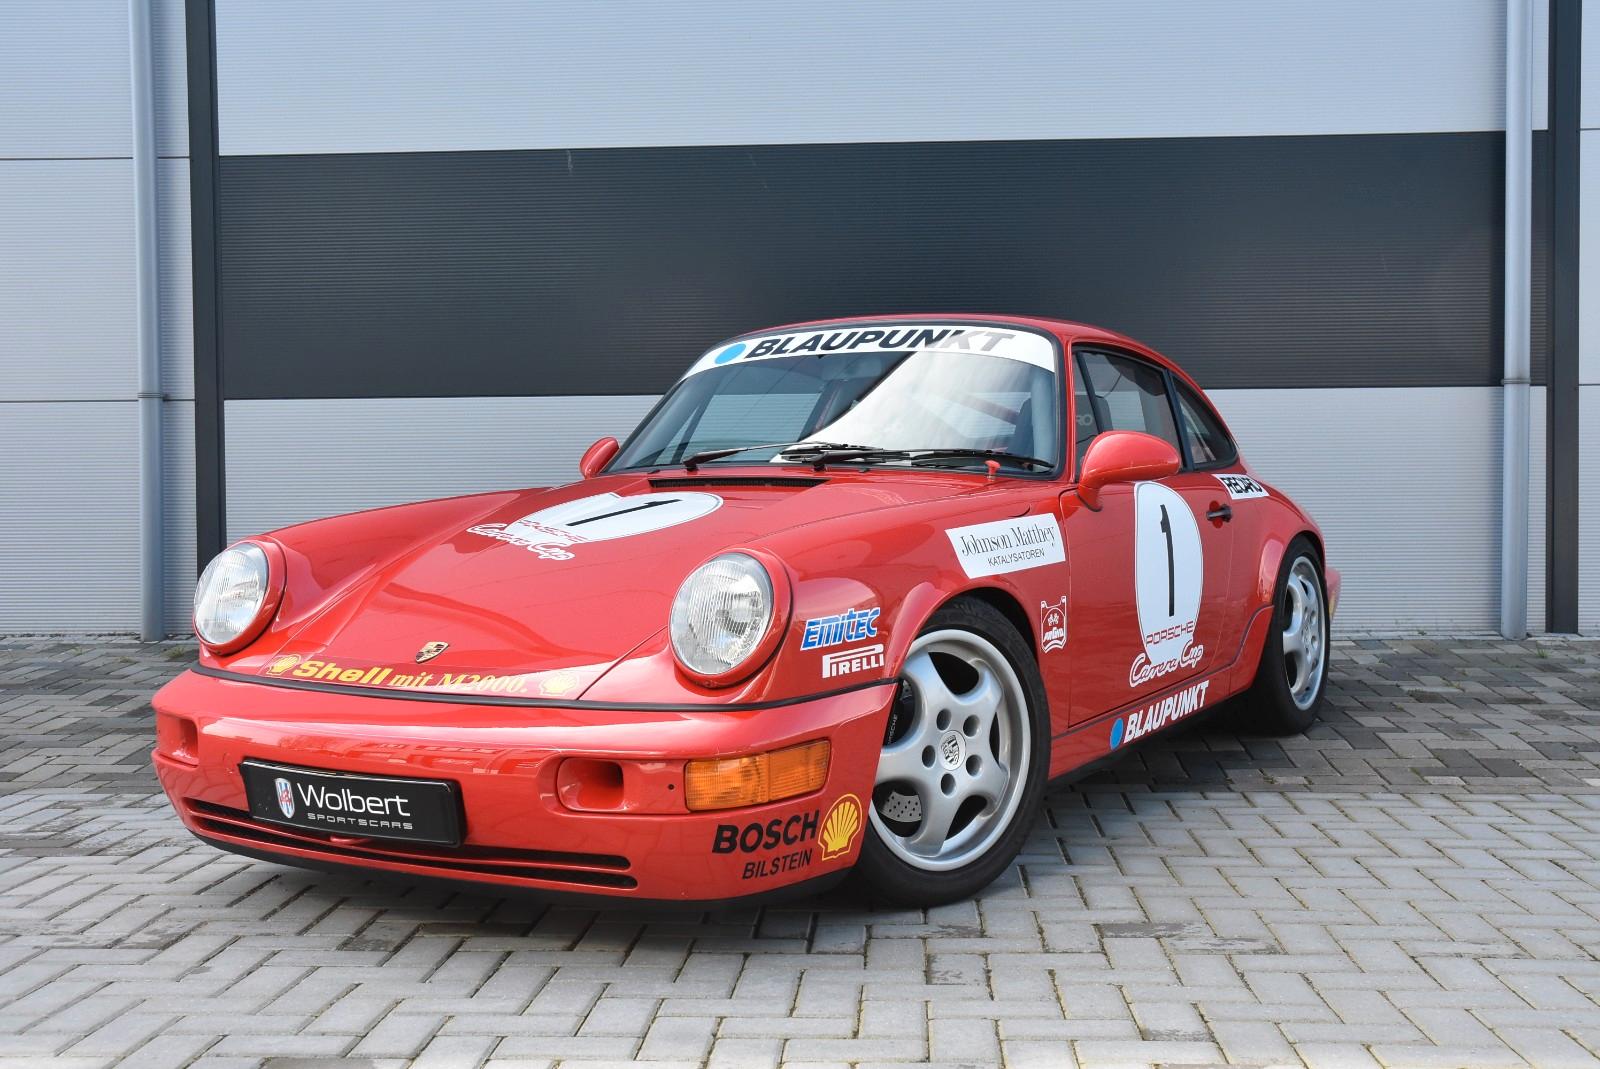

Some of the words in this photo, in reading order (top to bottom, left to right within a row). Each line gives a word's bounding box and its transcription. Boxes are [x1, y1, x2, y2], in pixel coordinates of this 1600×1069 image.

[745, 329, 1016, 359] BLAUPUNKT
[565, 499, 684, 527] 1
[960, 533, 1012, 557] Johnson
[1010, 523, 1056, 548] Matthey
[987, 548, 1045, 567] KATALYSATOREN
[1159, 503, 1175, 617] 1
[1145, 620, 1195, 647] PORSCHE
[292, 660, 394, 686] Shell
[386, 671, 435, 689] mit
[1129, 653, 1179, 688] Carrera
[1179, 638, 1204, 669] Cup
[1123, 680, 1209, 744] BLAUPUNKT
[296, 782, 411, 817] Wolbert
[307, 812, 413, 830] SPORTSCARS
[711, 808, 820, 854] BOSCH
[741, 848, 813, 880] BILSTEIN
